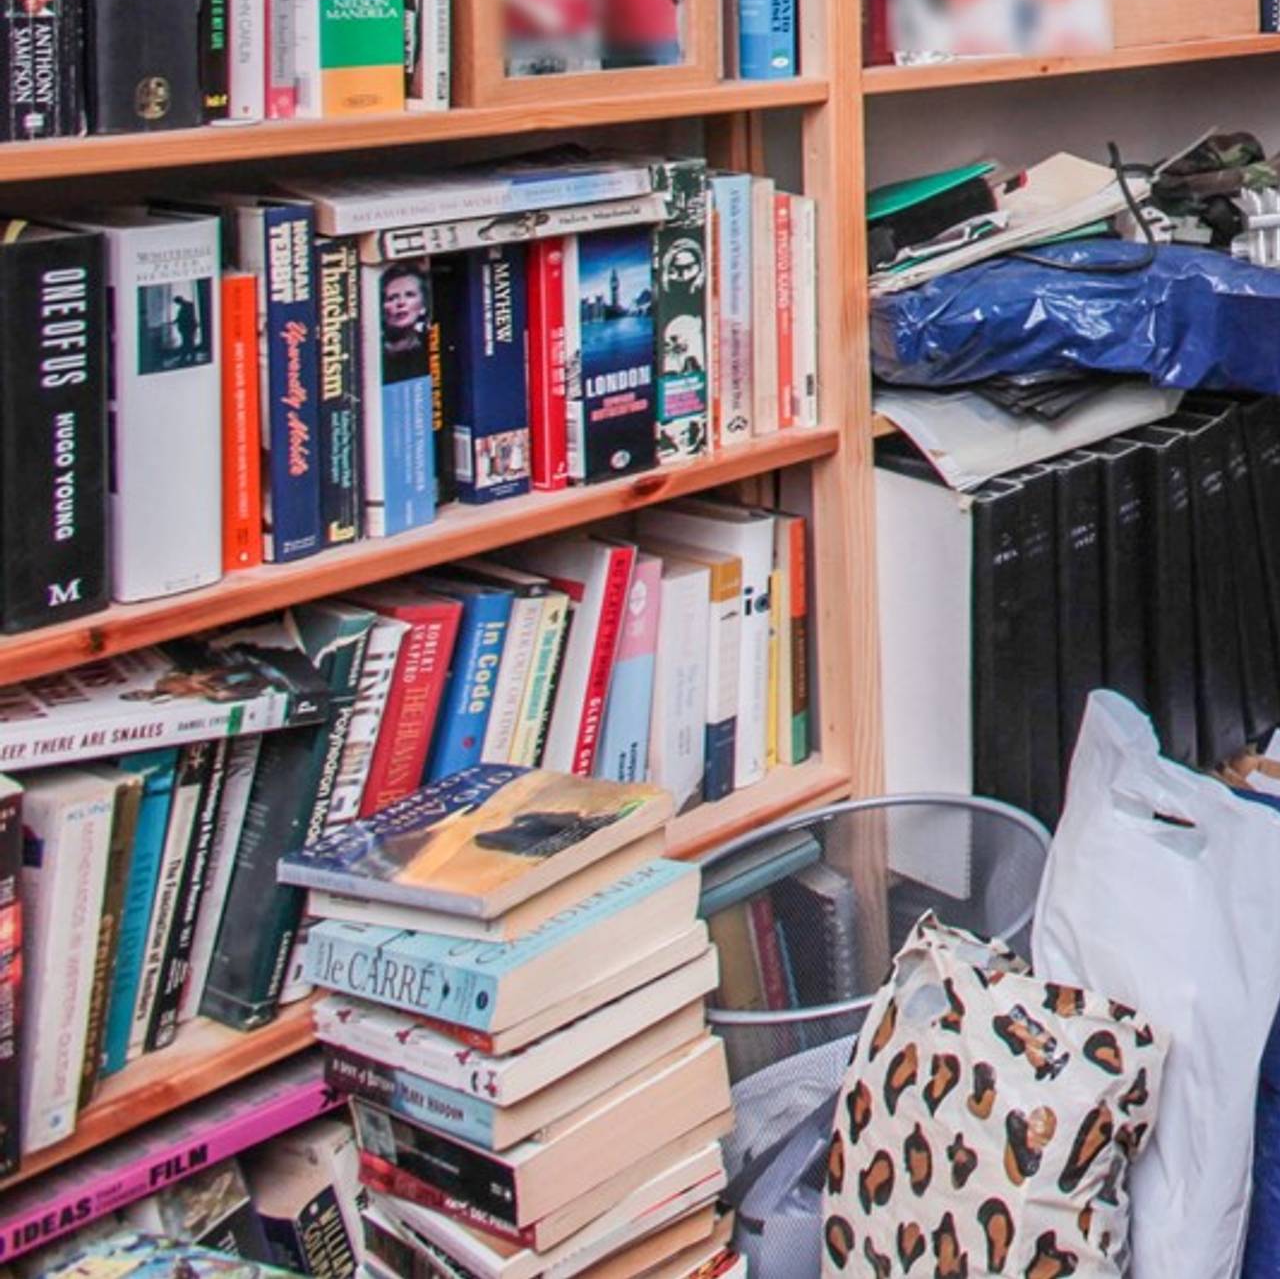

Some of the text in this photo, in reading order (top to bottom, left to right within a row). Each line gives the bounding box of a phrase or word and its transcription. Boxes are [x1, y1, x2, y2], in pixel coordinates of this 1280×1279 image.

[238, 17, 257, 64] CARLIN
[326, 7, 398, 19] MANDELA
[333, 0, 390, 9] NELSON
[14, 26, 37, 104] SAMPSON
[35, 23, 54, 105] ANTHONY
[269, 222, 291, 304] TEBBIT
[292, 220, 310, 302] NORMAN
[41, 268, 86, 388] ONE OF US
[321, 247, 349, 401] Thatcherism
[493, 262, 512, 343] MAYHEW
[281, 320, 309, 407] Upwardly
[54, 413, 75, 541] HUGO YOUNG
[402, 623, 426, 683] SHAPIRO
[419, 623, 442, 673] ROBERT
[469, 621, 506, 714] In Code
[33, 723, 164, 756] THERE ARE SNAKES
[318, 707, 351, 797] Polyhedron
[387, 684, 427, 787] THE HUMAN
[581, 696, 602, 746] GLENN
[136, 858, 181, 1021] The Fascination of Numbers
[323, 943, 436, 1013] le CARRÉ
[12, 1145, 209, 1250] IDEAS FILM
